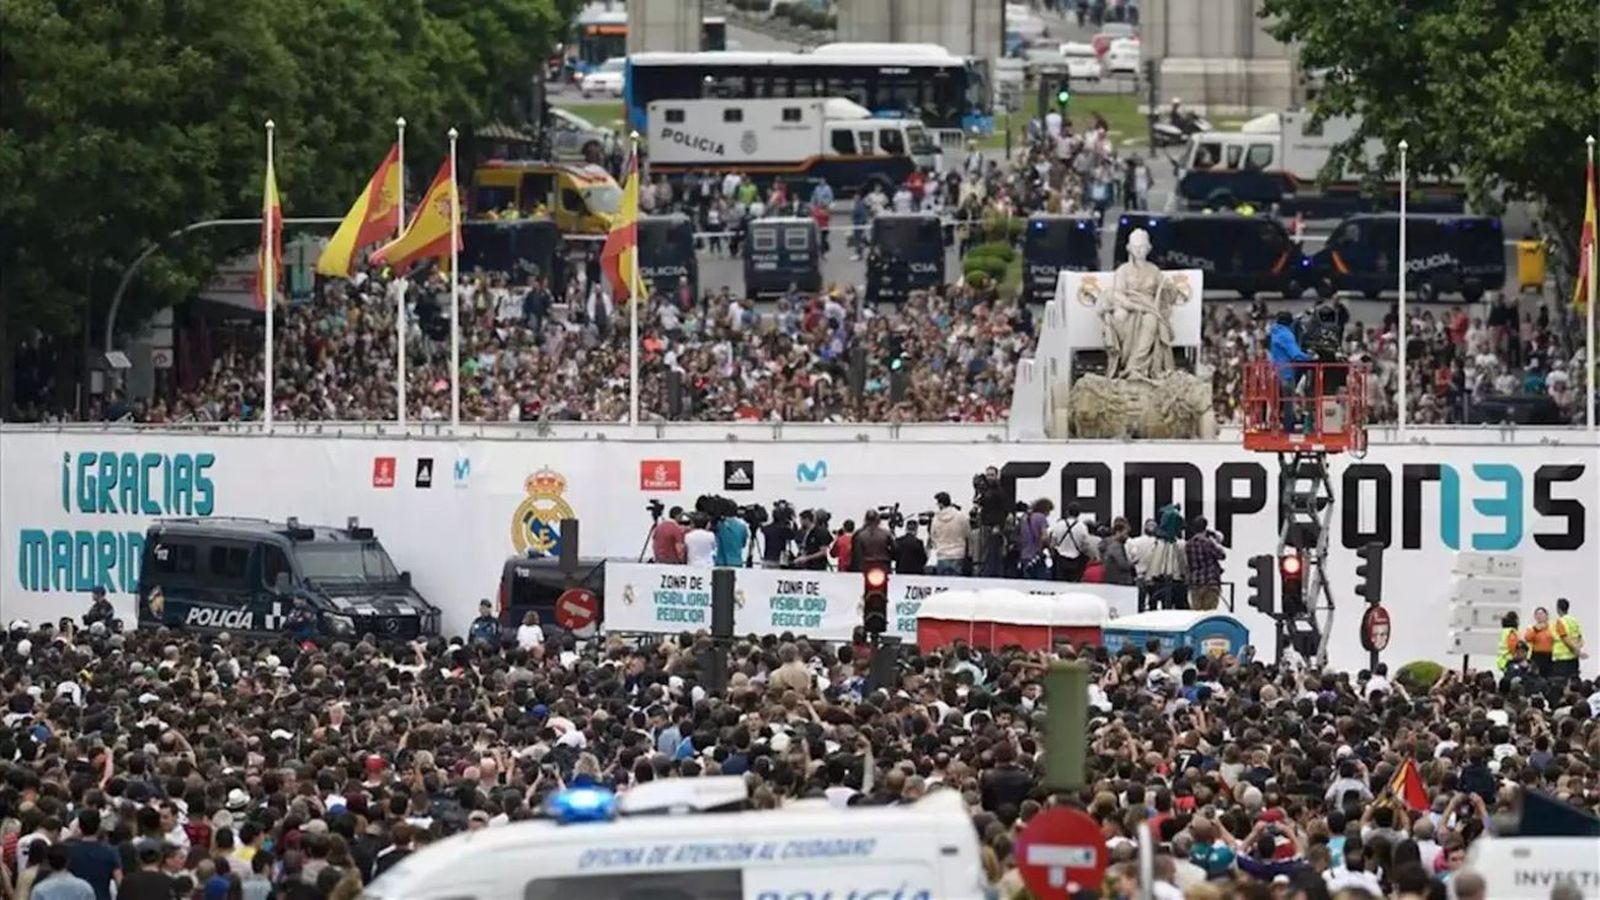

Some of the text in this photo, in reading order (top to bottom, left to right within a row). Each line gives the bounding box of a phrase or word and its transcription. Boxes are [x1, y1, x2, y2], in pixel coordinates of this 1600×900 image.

[661, 128, 725, 155] POLICIA
[19, 529, 147, 594] MADRID
[661, 575, 703, 590] ZONA DE
[777, 580, 819, 595] ZONA DE
[185, 604, 253, 629] POLICÍA
[1180, 755, 1190, 771] 7
